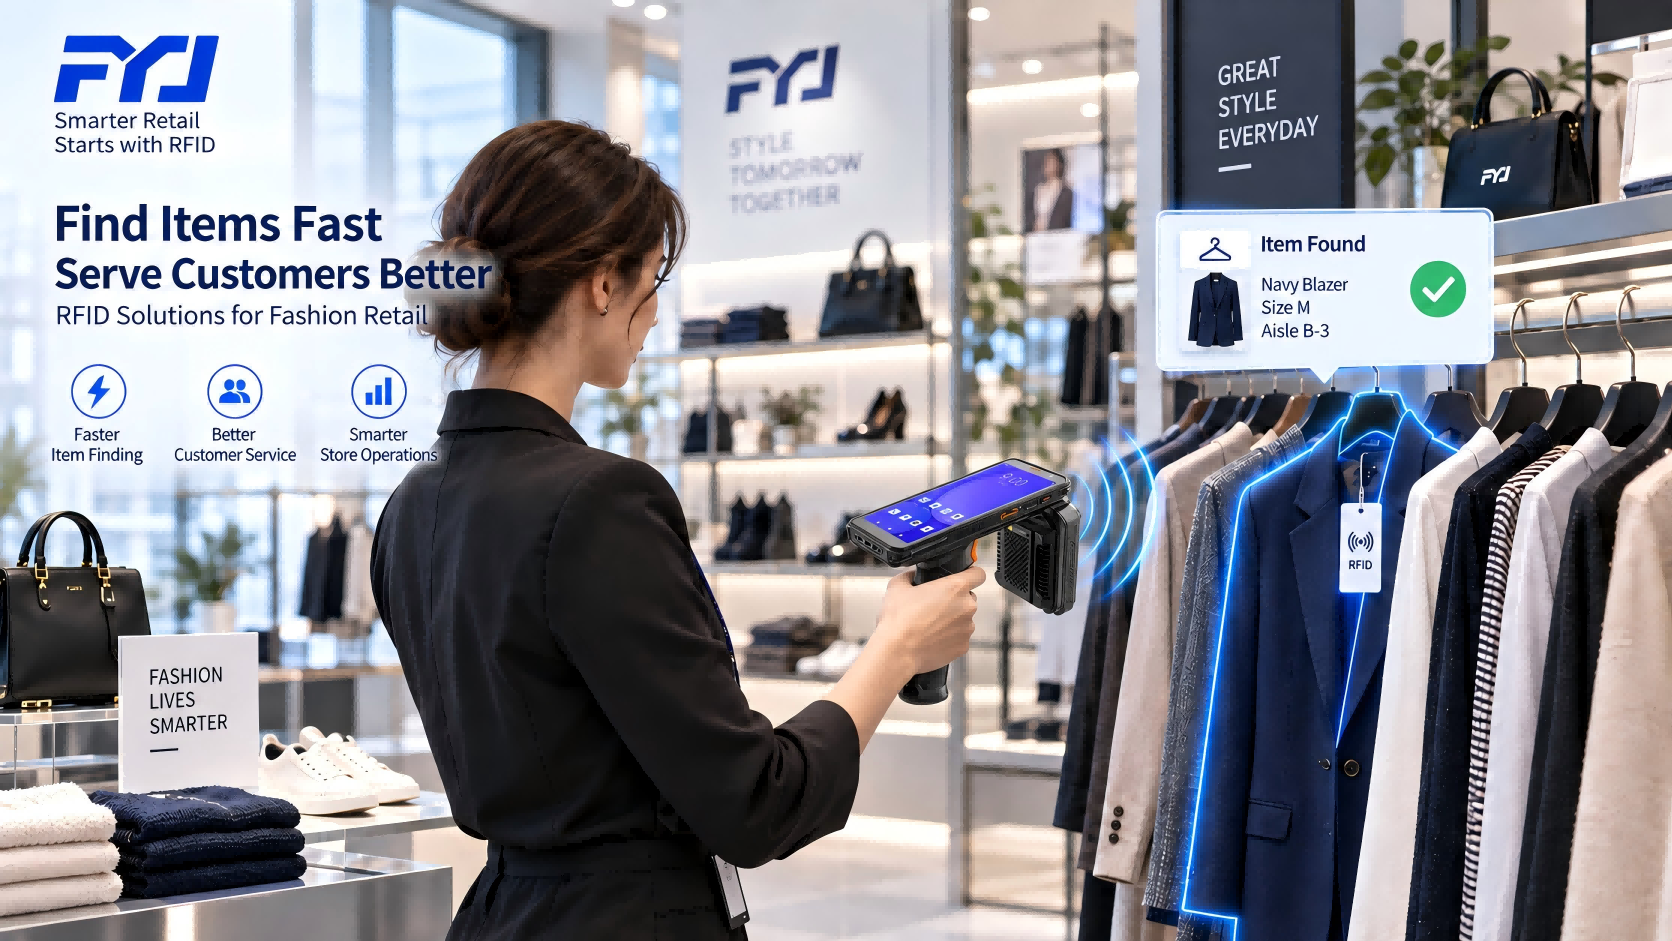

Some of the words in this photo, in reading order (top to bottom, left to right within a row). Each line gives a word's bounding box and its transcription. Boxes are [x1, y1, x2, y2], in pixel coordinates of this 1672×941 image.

[726, 44, 839, 114] FYJ
[1218, 55, 1281, 85] GREAT
[1218, 89, 1277, 117] STYLE
[729, 131, 793, 158] STYLE
[1218, 114, 1319, 149] EVERYDAY
[730, 152, 864, 185] TOMORROW
[1480, 165, 1511, 186] FYJ
[730, 183, 841, 214] TOGETHER
[1348, 559, 1373, 570] RFID
[149, 666, 223, 685] FASHION
[149, 691, 196, 710] LIVES
[149, 713, 228, 735] SMARTER
